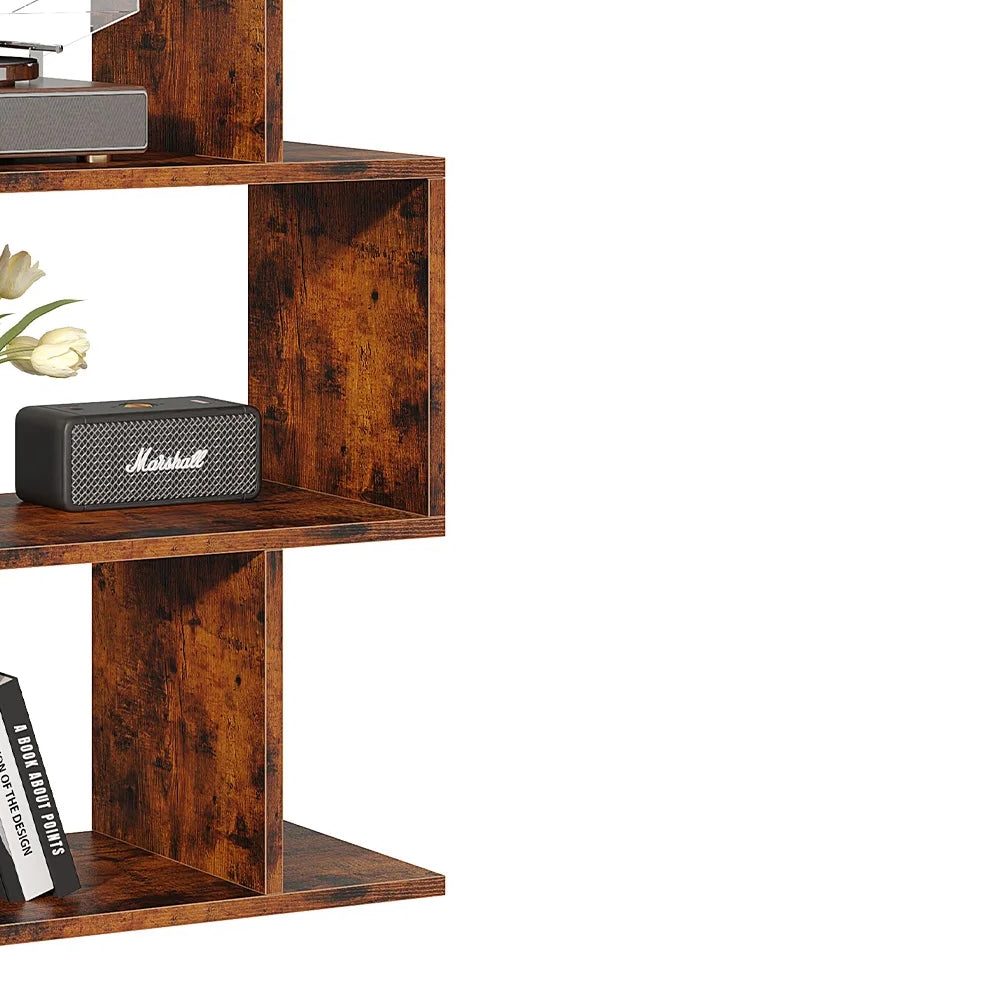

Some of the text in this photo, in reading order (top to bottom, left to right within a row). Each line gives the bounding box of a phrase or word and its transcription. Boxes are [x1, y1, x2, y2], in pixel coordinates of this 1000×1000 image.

[126, 447, 208, 473] Marshall
[1, 773, 11, 789] OF
[13, 723, 65, 857] A BOOK ABOUT POINTS
[4, 789, 18, 814] THE
[12, 815, 33, 857] DESIGN
